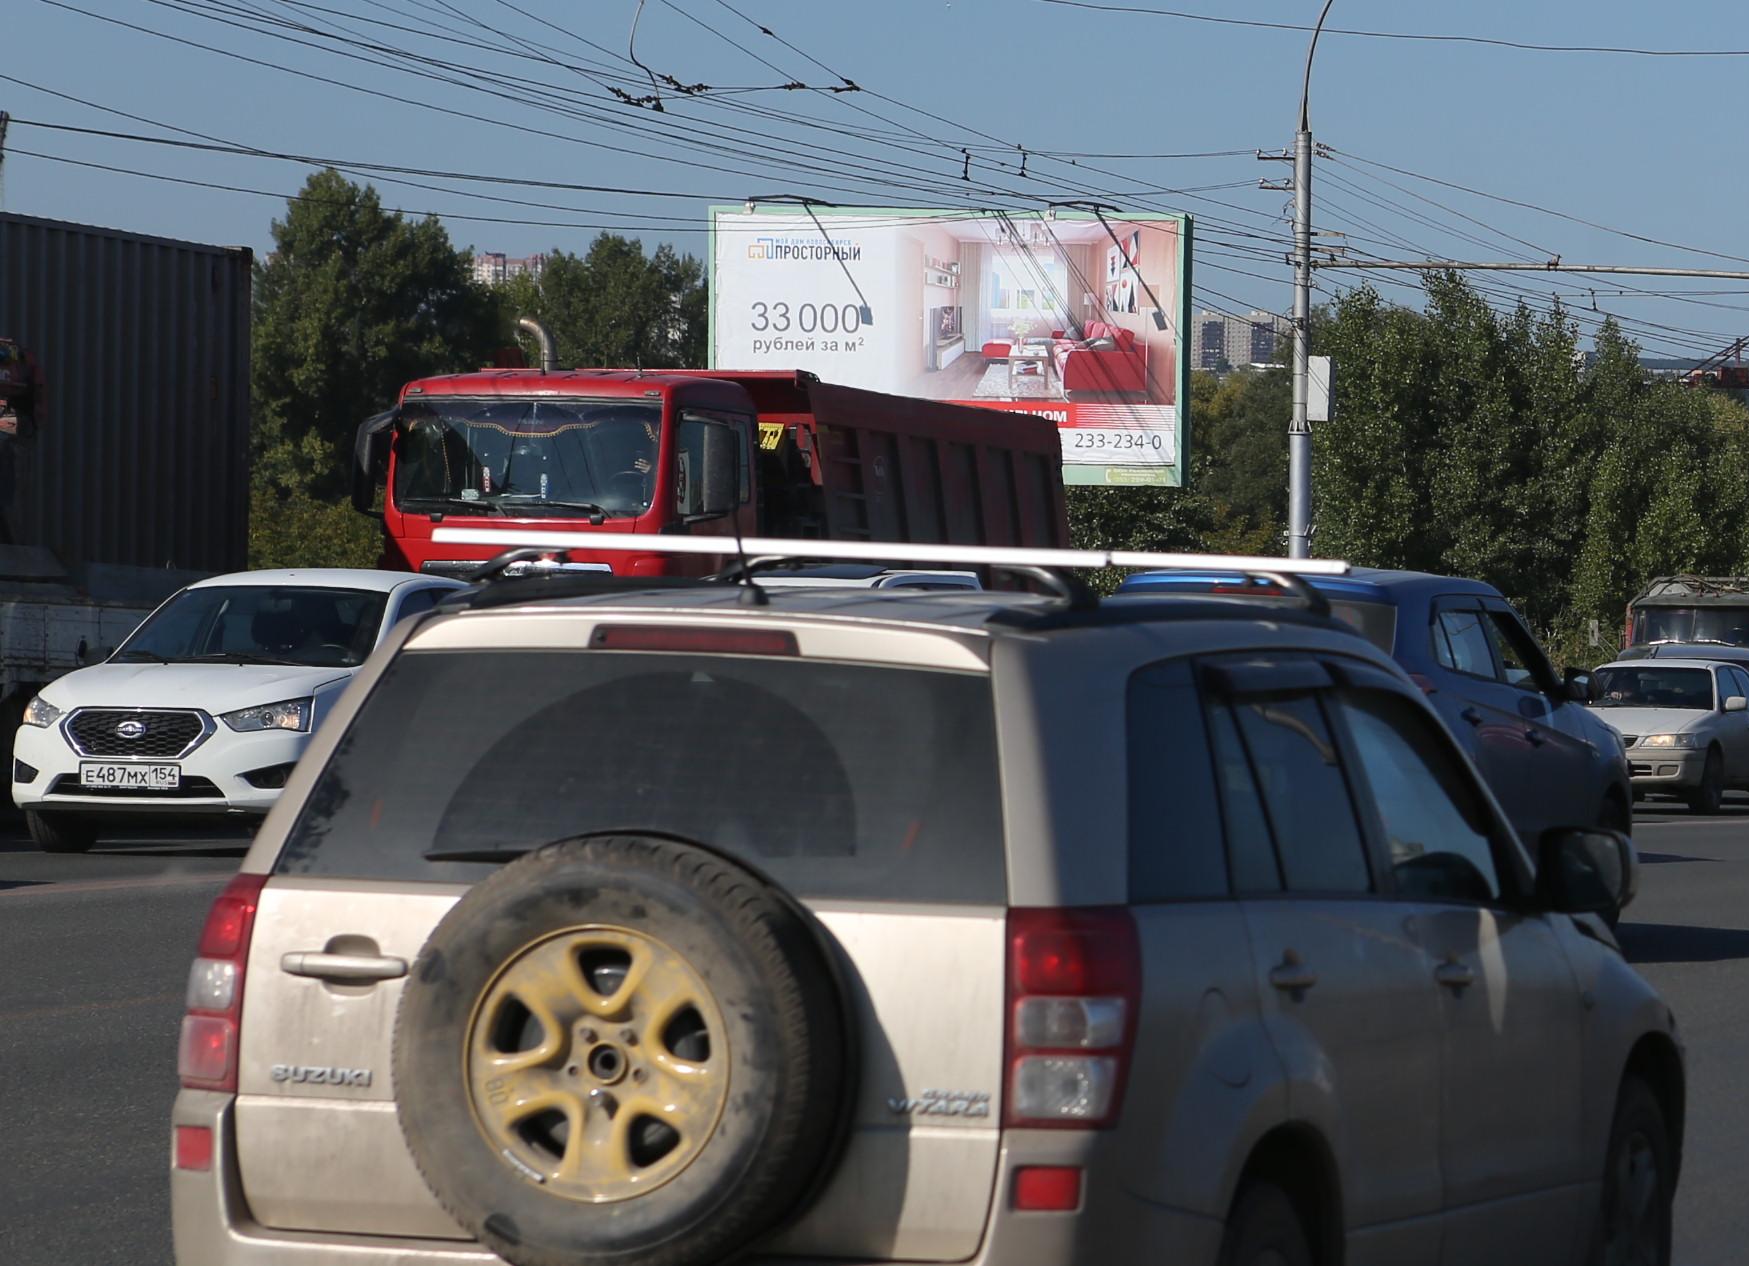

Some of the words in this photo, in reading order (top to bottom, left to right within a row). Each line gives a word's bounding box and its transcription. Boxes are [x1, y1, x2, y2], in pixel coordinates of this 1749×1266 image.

[775, 242, 861, 261] ПРОСТОРНЫЙ
[753, 336, 815, 354] рублей
[821, 340, 839, 351] за
[1075, 433, 1162, 450] 233-234-0
[85, 767, 148, 785] Е487МХ
[152, 768, 177, 780] 154
[272, 1065, 373, 1087] SUZUKI
[887, 1098, 989, 1117] VITARA
